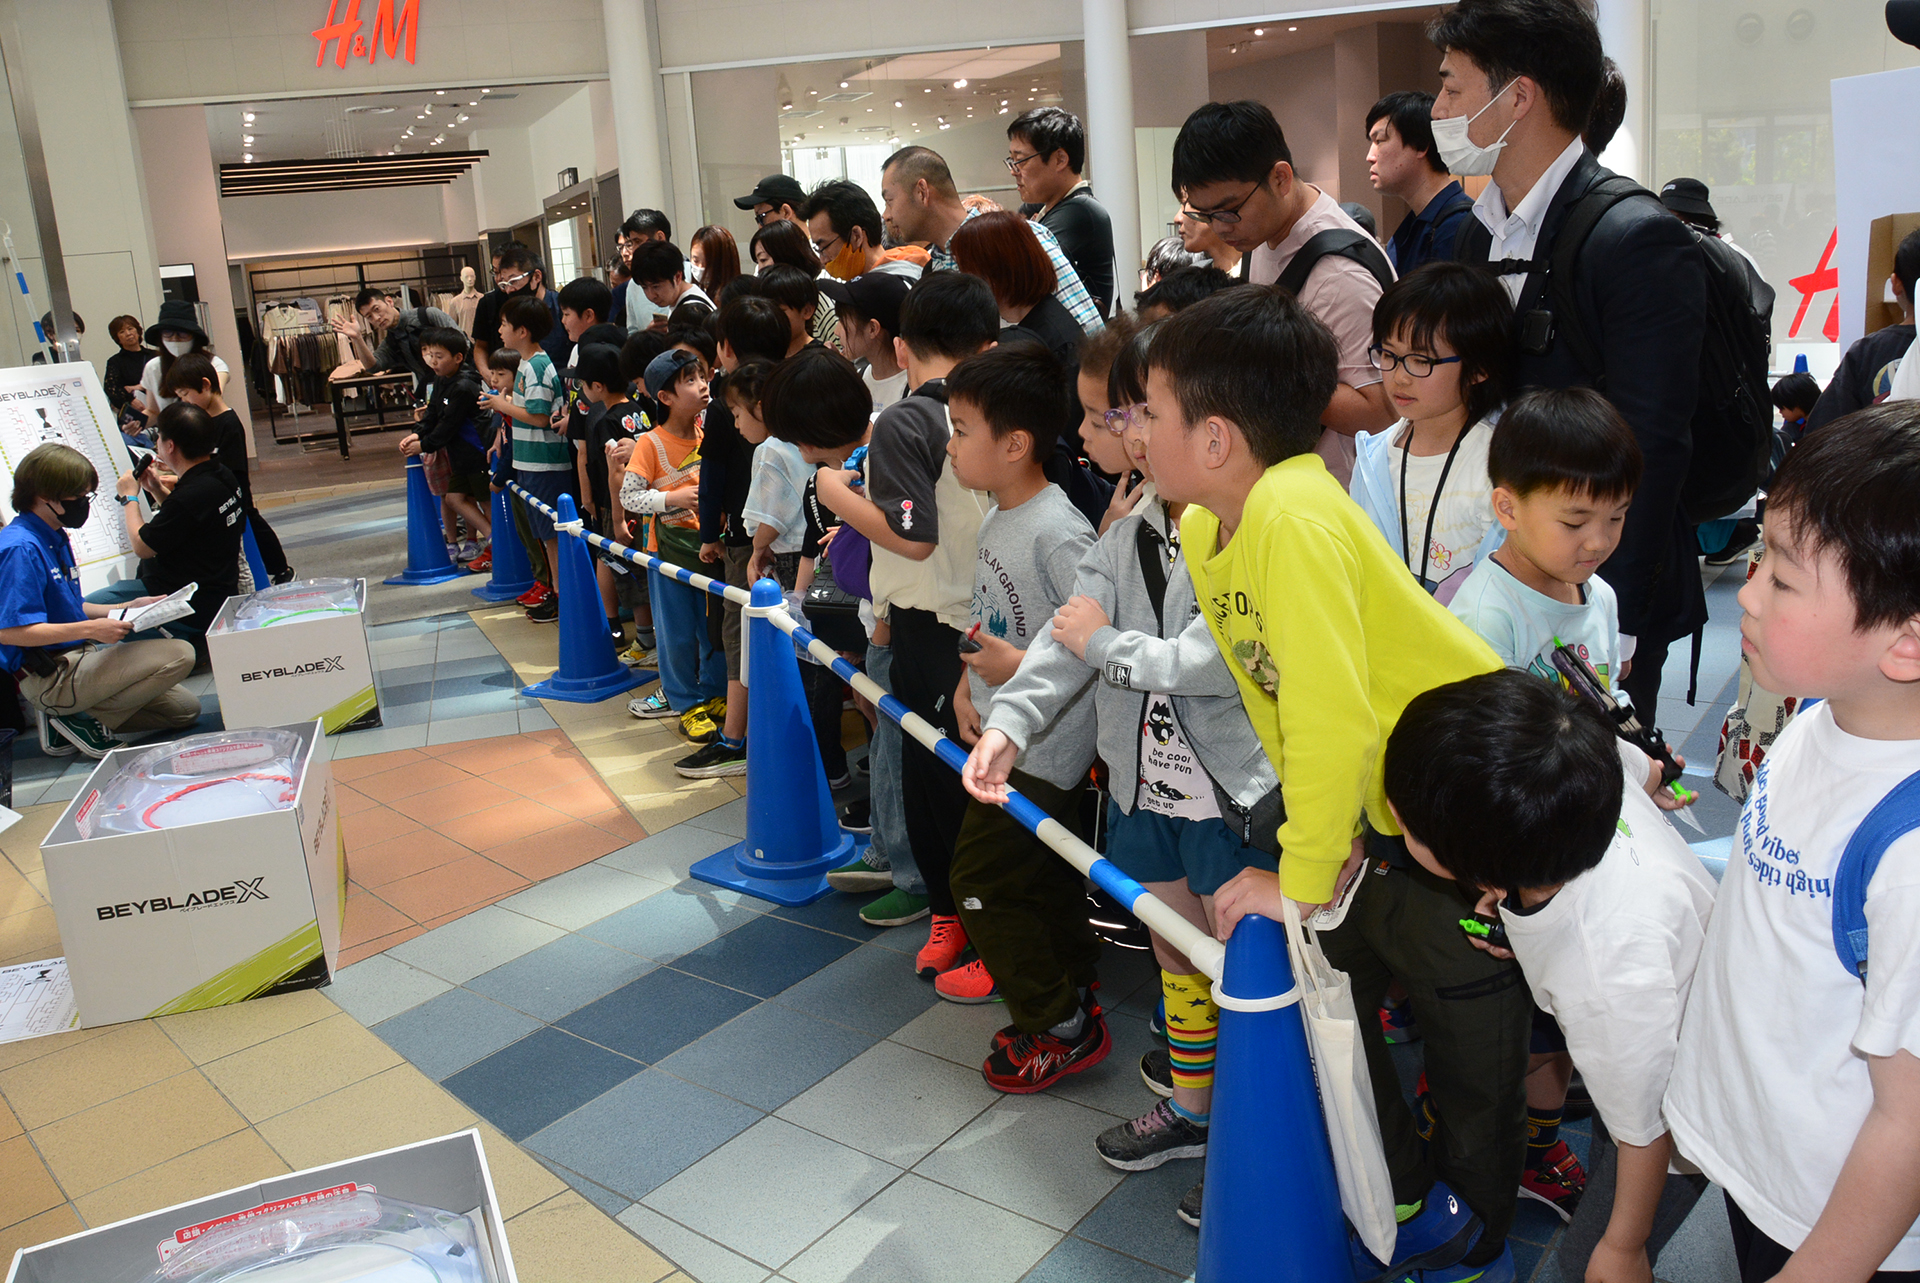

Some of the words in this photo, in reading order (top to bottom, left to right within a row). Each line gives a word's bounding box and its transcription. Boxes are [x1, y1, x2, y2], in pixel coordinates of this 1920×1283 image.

[311, 0, 420, 70] H&M
[1148, 755, 1171, 770] have
[1174, 763, 1192, 775] fun
[1152, 748, 1164, 758] be
[1166, 753, 1191, 763] cool
[1754, 793, 1770, 839] good
[1761, 835, 1801, 866] vibes
[1747, 852, 1782, 887] tides
[1785, 868, 1831, 898] high
